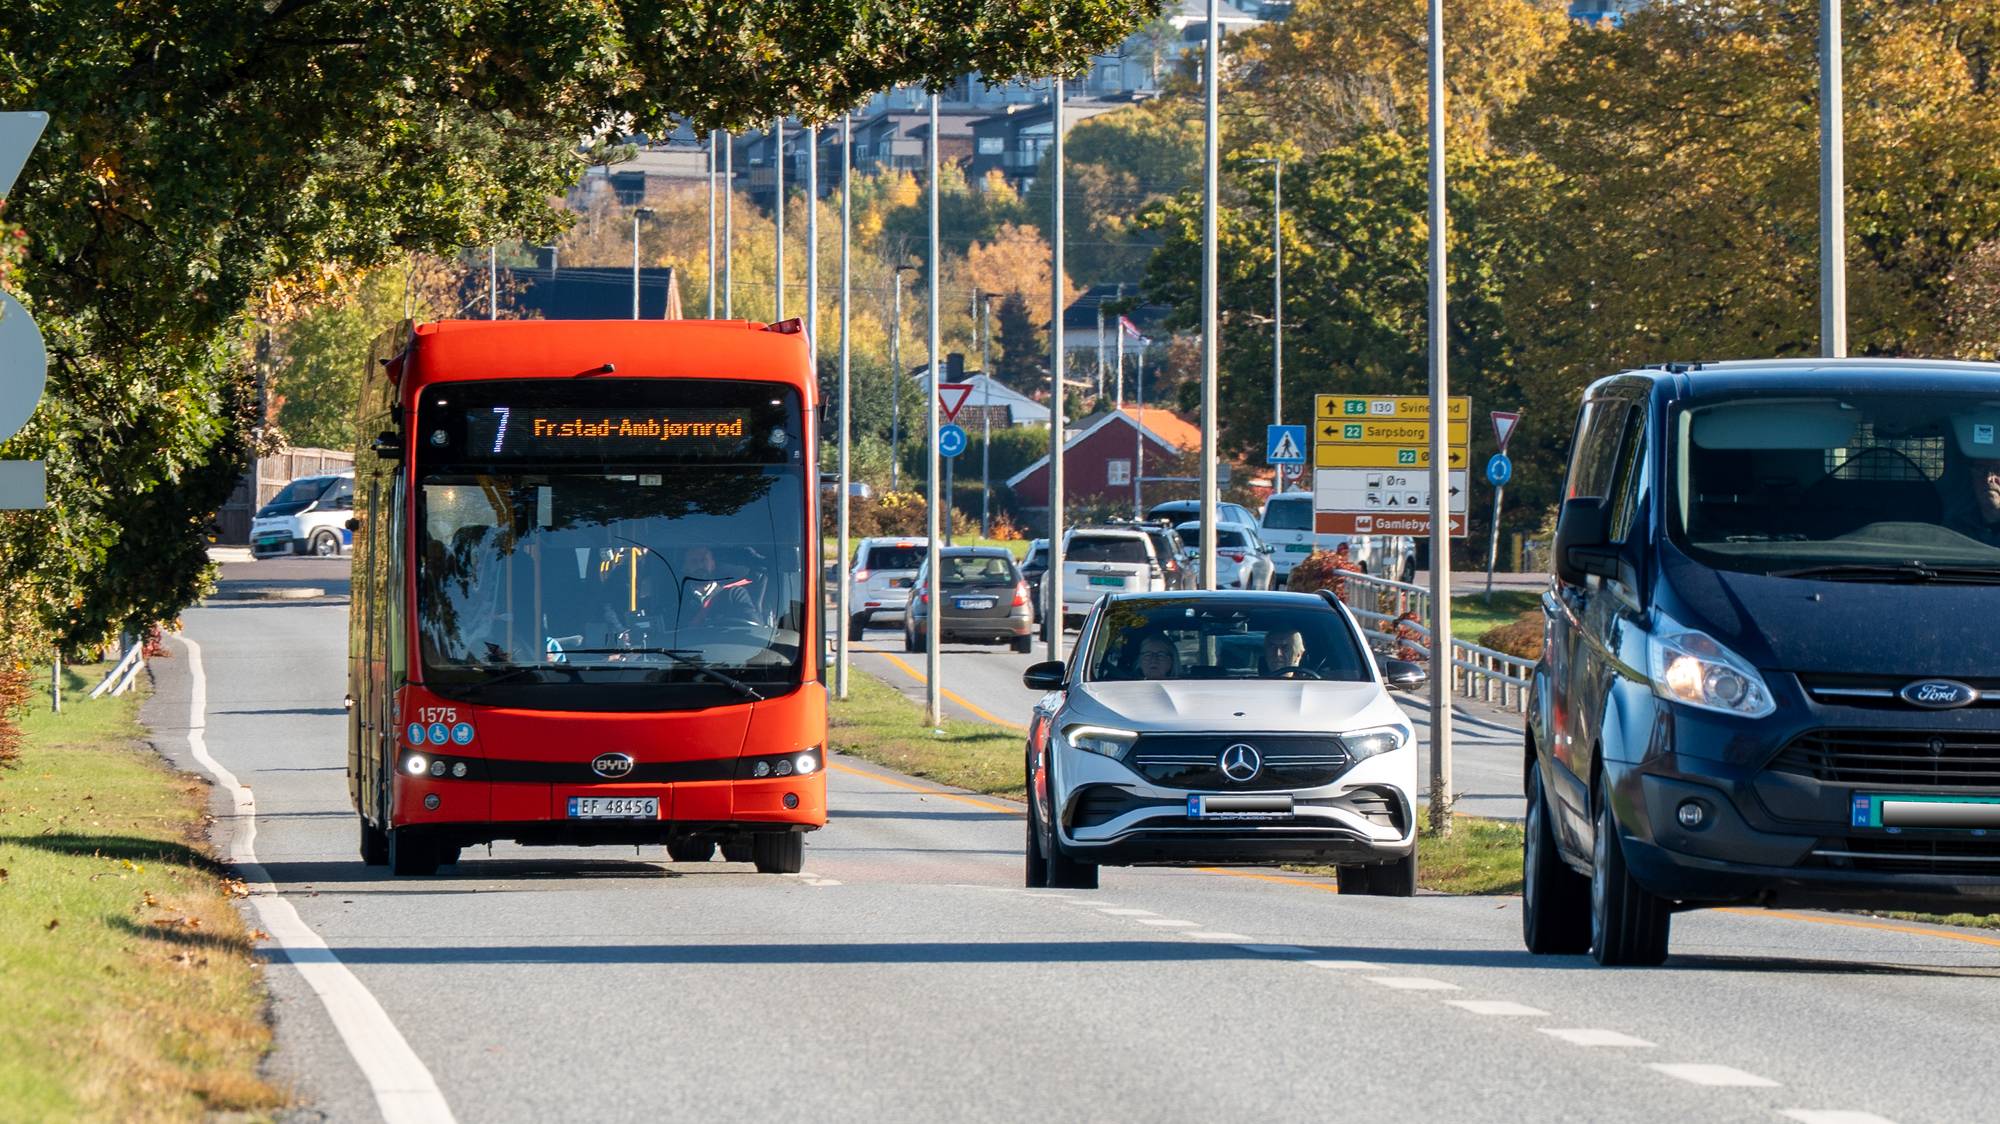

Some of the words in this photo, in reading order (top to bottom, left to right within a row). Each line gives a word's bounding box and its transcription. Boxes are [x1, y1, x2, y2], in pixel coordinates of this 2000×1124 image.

[1357, 402, 1364, 412] 6
[1374, 403, 1392, 412] 130
[1400, 402, 1460, 414] Svinend
[493, 407, 509, 453] 7
[533, 418, 742, 441] Fr.stad-Ambjørnrød
[1346, 427, 1360, 437] 22
[1367, 426, 1425, 439] Sarpsborg
[1400, 452, 1414, 462] 22
[1386, 475, 1407, 486] Øra
[1376, 518, 1431, 532] Gamleby
[1917, 684, 1957, 701] Ford
[418, 707, 457, 723] 1575
[596, 759, 628, 771] BYD
[582, 799, 599, 814] EF
[606, 799, 653, 814] 48456
[1858, 815, 1866, 823] N
